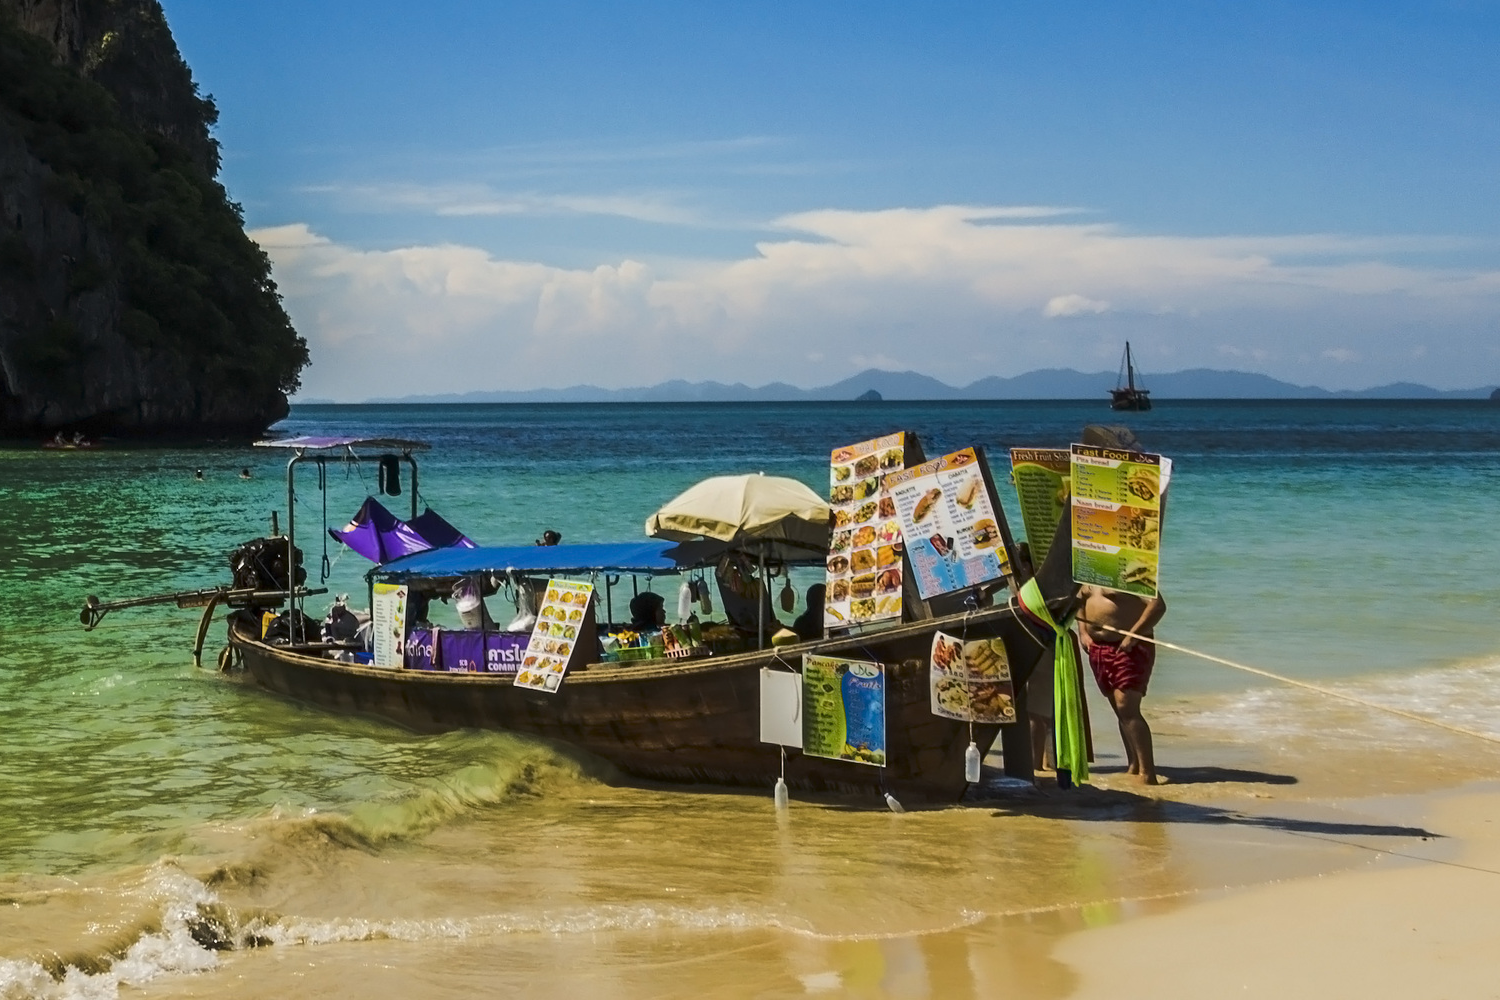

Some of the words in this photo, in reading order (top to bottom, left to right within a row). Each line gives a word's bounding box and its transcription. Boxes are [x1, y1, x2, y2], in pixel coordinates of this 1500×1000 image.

[878, 434, 900, 450] FOOD
[1013, 450, 1033, 460] Fresh
[1034, 451, 1052, 460] Fruit
[1076, 448, 1098, 457] Fast
[1102, 450, 1130, 460] Food
[889, 471, 916, 485] FAST
[919, 460, 948, 475] FOOD
[1076, 500, 1092, 508] Naan
[1094, 502, 1113, 510] bread
[1076, 541, 1106, 550] Sandwich
[806, 657, 839, 670] Pancake
[854, 664, 874, 676] حلال
